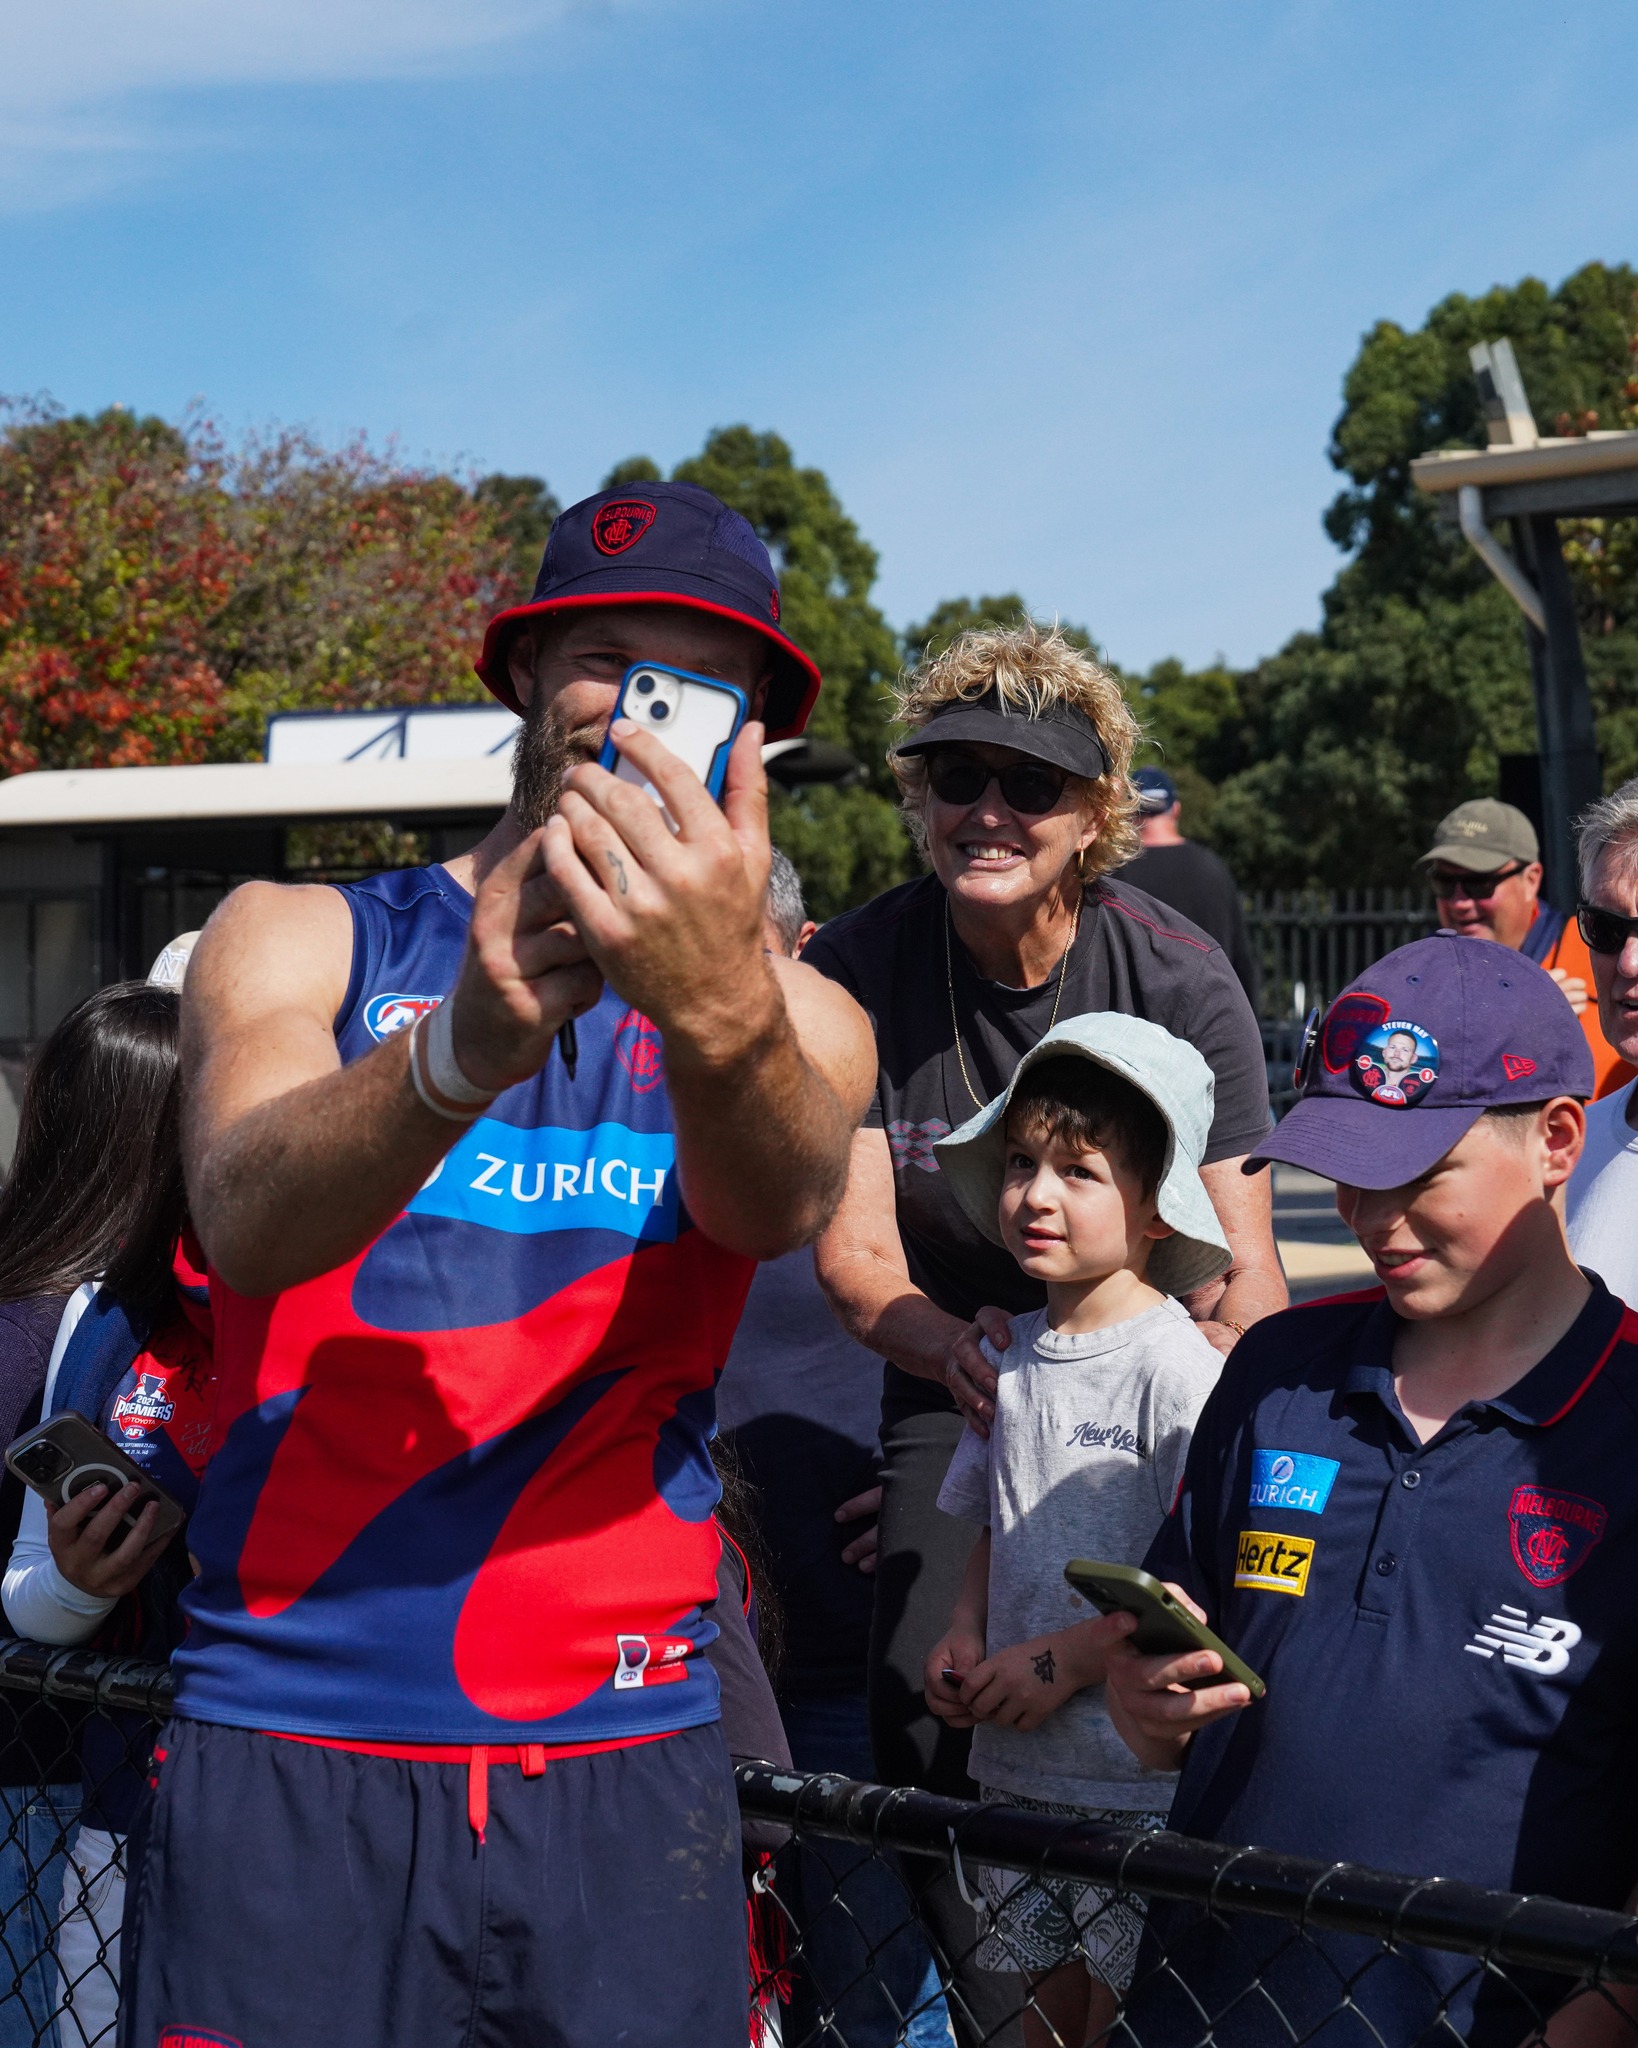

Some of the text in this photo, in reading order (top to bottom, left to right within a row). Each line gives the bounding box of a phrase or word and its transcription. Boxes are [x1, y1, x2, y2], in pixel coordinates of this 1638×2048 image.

[1382, 1021, 1429, 1039] STEVEN MAY
[1379, 1090, 1399, 1099] AFL
[469, 1152, 667, 1206] ZURICH
[115, 1400, 173, 1421] PREMIERS
[137, 1395, 155, 1406] 2021
[131, 1416, 156, 1425] TOYOTA
[126, 1428, 145, 1437] AFL
[1066, 1421, 1113, 1447] New
[1250, 1484, 1318, 1507] ZURICH
[1515, 1493, 1602, 1535] MELBOURNE
[1237, 1537, 1308, 1578] Hertz
